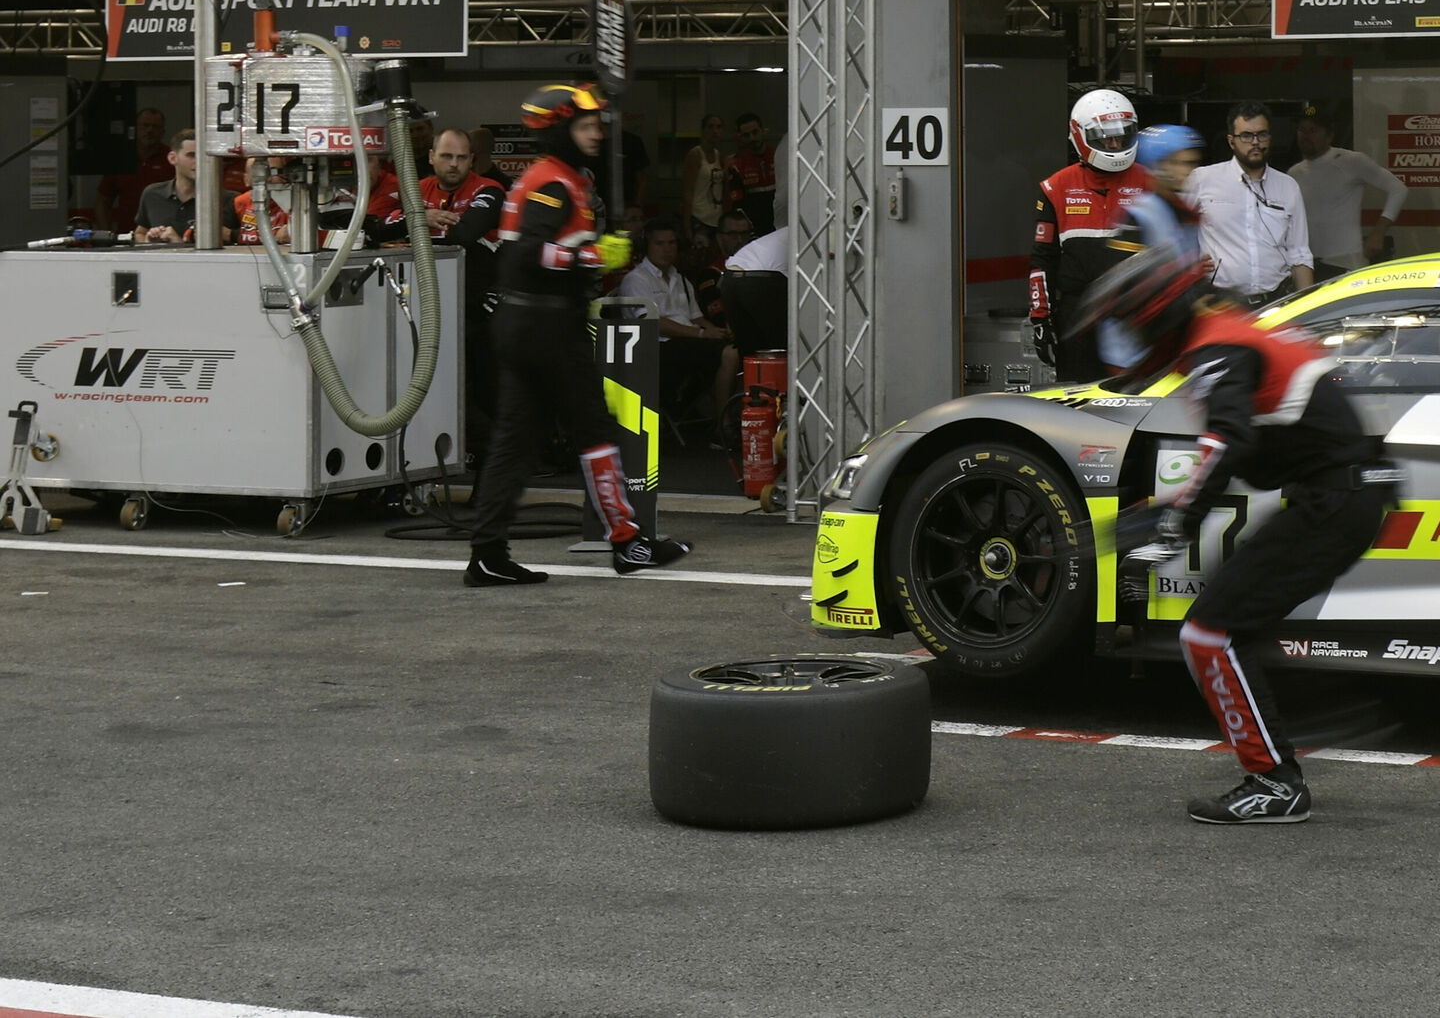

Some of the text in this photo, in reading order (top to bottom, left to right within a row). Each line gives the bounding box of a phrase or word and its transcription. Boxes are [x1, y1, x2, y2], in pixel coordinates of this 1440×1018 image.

[126, 18, 164, 34] AUDI
[166, 18, 187, 33] R8
[216, 81, 235, 132] 2
[255, 82, 300, 134] 17
[885, 114, 943, 160] 40
[1065, 196, 1093, 205] TOTAL
[293, 263, 307, 288] 2
[1367, 270, 1426, 286] LEONARD
[606, 324, 641, 364] 17
[74, 347, 236, 390] WRT
[54, 391, 210, 404] w-racingteam.com
[1018, 464, 1079, 546] P ZERO
[826, 605, 874, 626] PIRELLI
[896, 575, 948, 653] PIRELLI
[1310, 648, 1368, 659] NAVIGATOR
[1311, 641, 1339, 650] RACE
[1205, 655, 1249, 748] TOTAL
